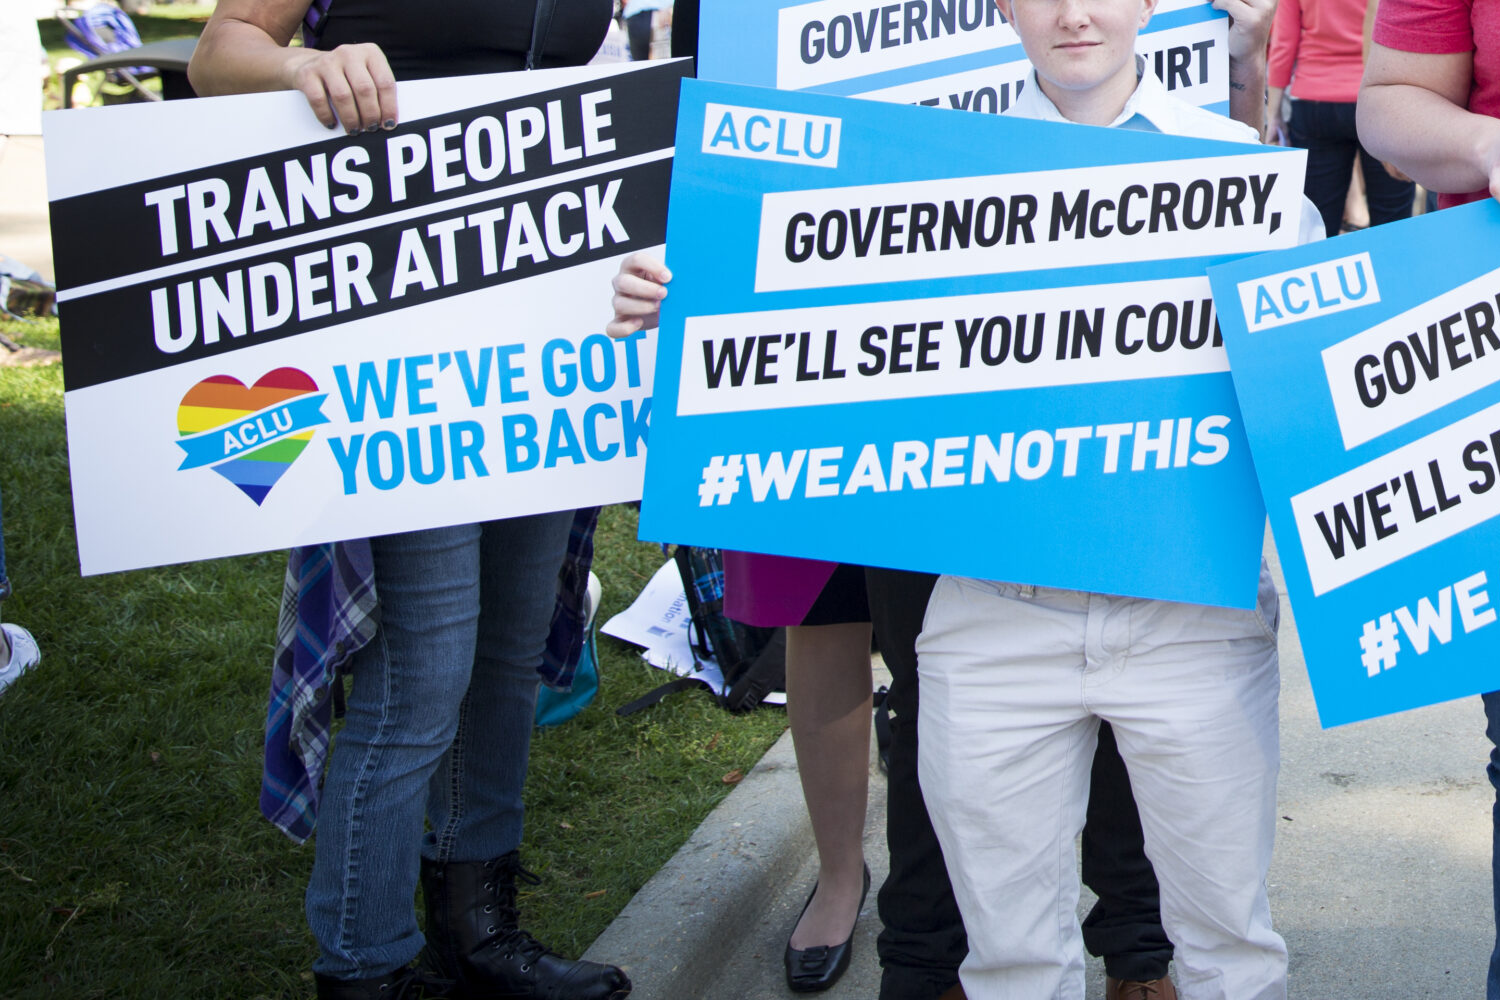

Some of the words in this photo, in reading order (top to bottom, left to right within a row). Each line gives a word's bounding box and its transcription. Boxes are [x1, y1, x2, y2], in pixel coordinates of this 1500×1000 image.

[145, 146, 373, 256] TRANS
[387, 88, 616, 203] PEOPLE
[709, 111, 832, 160] ACLU
[784, 192, 1038, 263] GOVERNOR
[1048, 172, 1283, 240] McCRORY,
[150, 242, 378, 354] UNDER
[390, 179, 630, 299] ATTACK
[1252, 260, 1369, 322] ACLU
[333, 343, 529, 424] WE'VE
[541, 331, 647, 397] GOT
[701, 329, 847, 389] WE'LL
[857, 320, 944, 377] SEE
[954, 313, 1044, 369] YOU
[1055, 308, 1104, 361] IN
[1114, 298, 1225, 356] COU
[222, 407, 295, 457] ACLU
[327, 421, 490, 495] YOUR
[502, 396, 654, 474] BACK
[697, 415, 1231, 507] #WEARENOTTHIS
[1314, 459, 1461, 560] WE'LL
